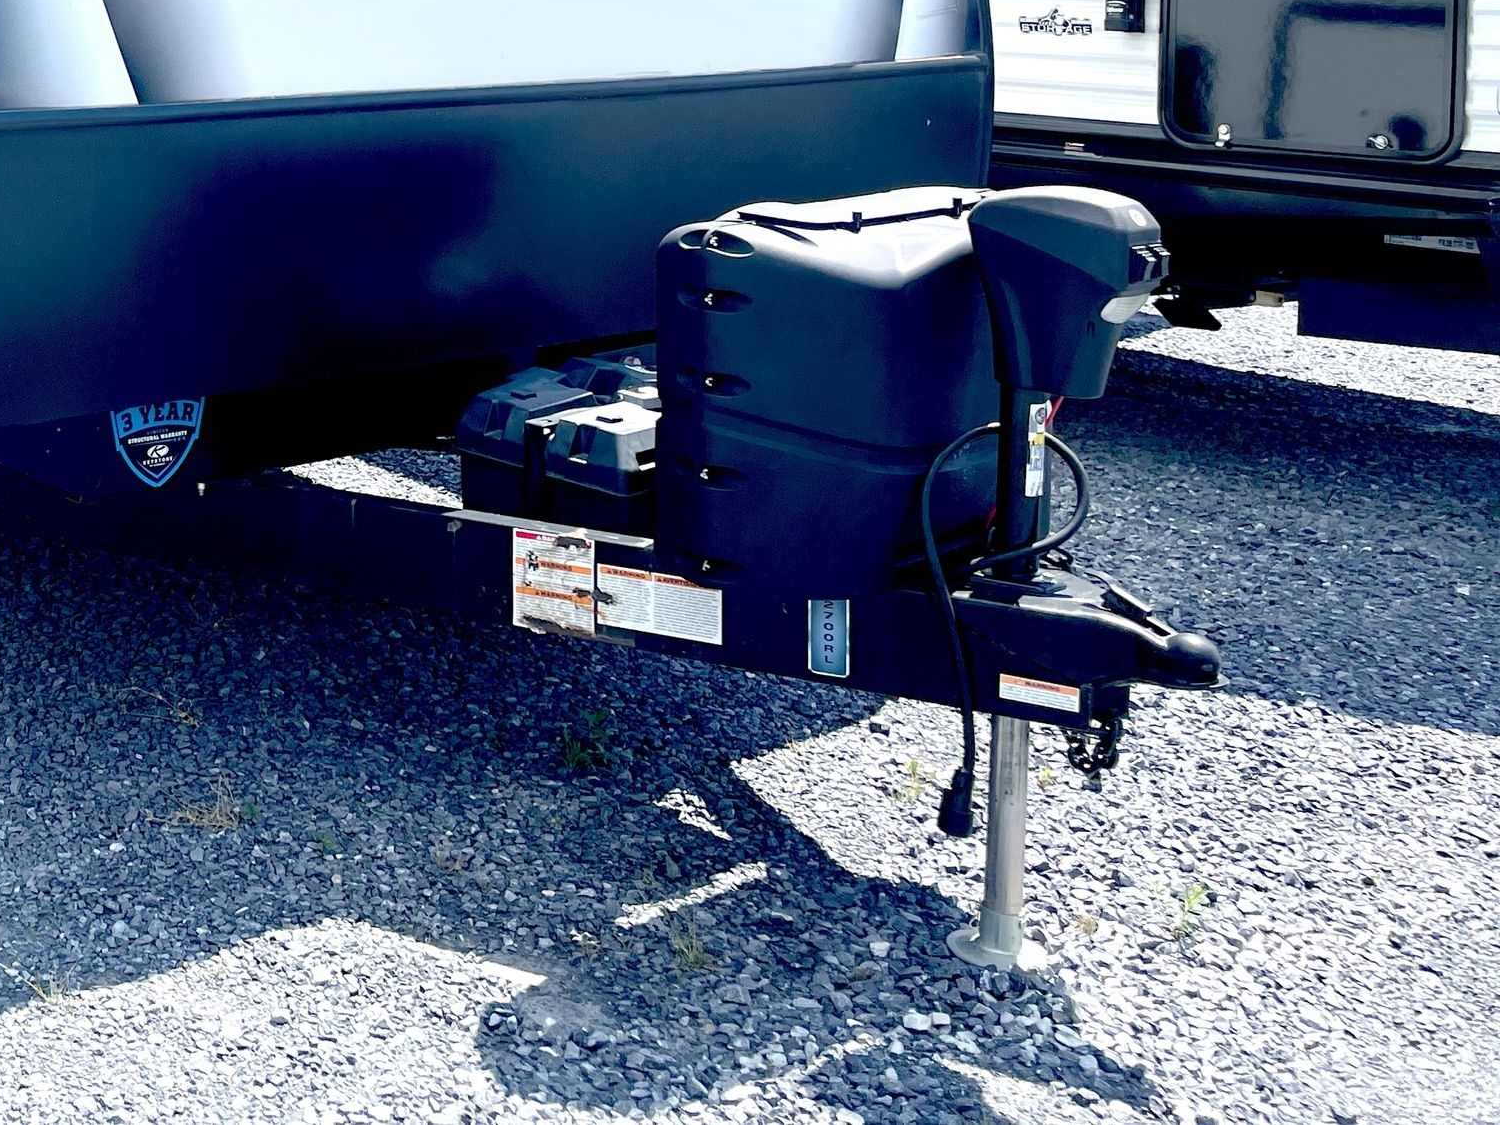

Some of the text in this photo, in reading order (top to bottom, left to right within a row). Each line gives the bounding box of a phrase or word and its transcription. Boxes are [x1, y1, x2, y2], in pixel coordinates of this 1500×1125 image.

[121, 402, 196, 433] 3 YEAR
[127, 434, 160, 445] STRUCTURAL
[160, 430, 188, 440] WARRANTY
[540, 561, 573, 572] WARNING
[612, 568, 646, 580] WARNING
[540, 589, 573, 601] WARNING
[823, 600, 834, 664] 2700RL
[1024, 680, 1061, 692] WARNING
